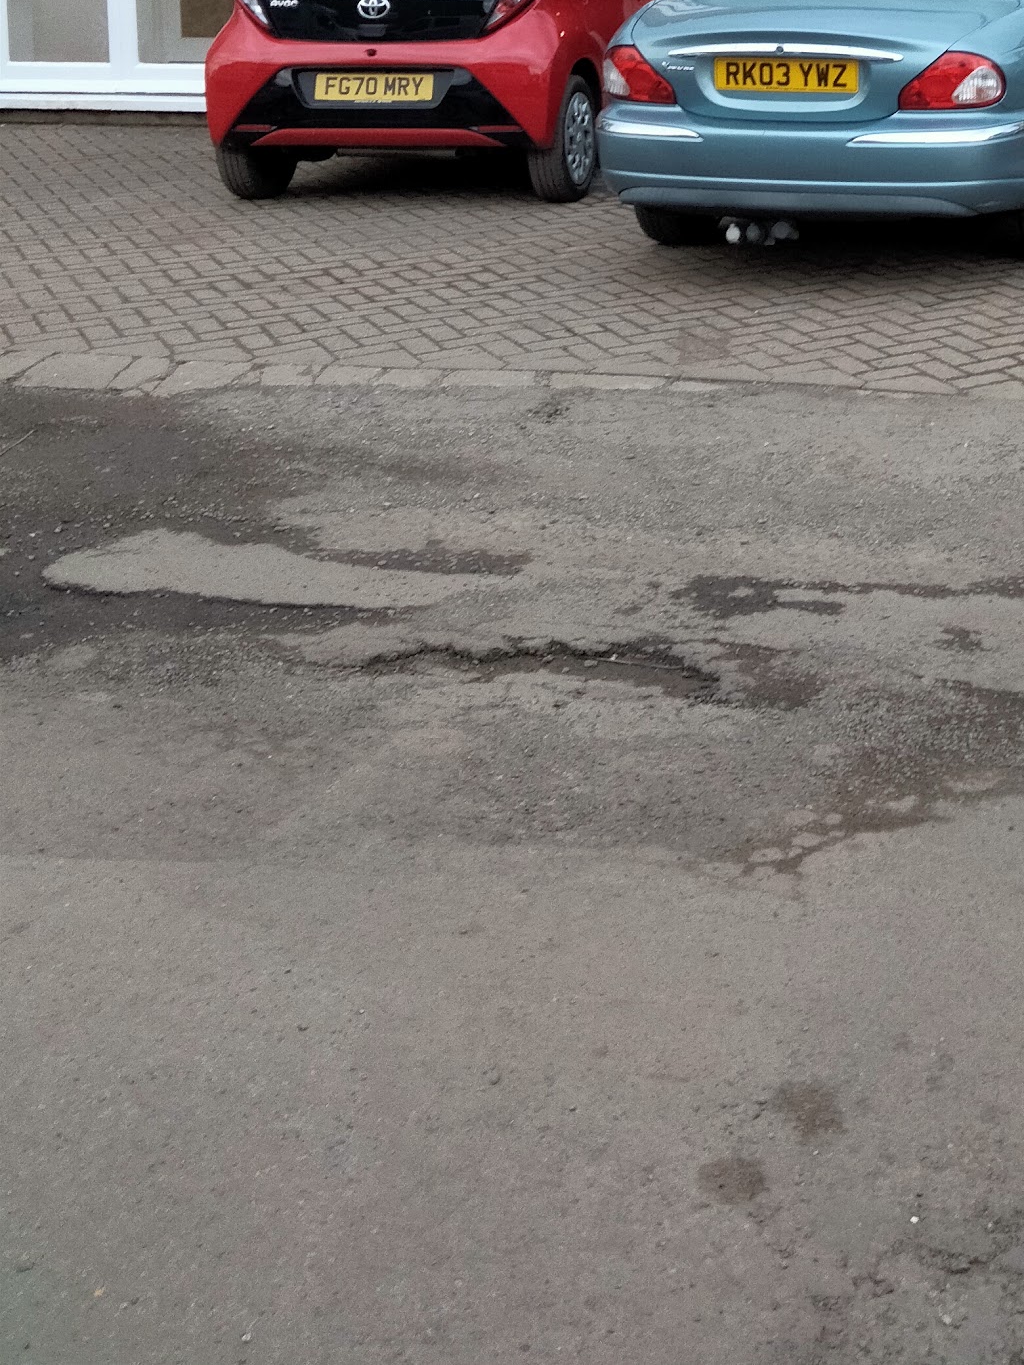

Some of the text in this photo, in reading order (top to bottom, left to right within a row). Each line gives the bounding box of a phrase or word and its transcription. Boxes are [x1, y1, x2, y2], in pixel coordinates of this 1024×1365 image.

[725, 62, 847, 87] RK03 YWZ
[324, 76, 424, 96] FG70 MRY
